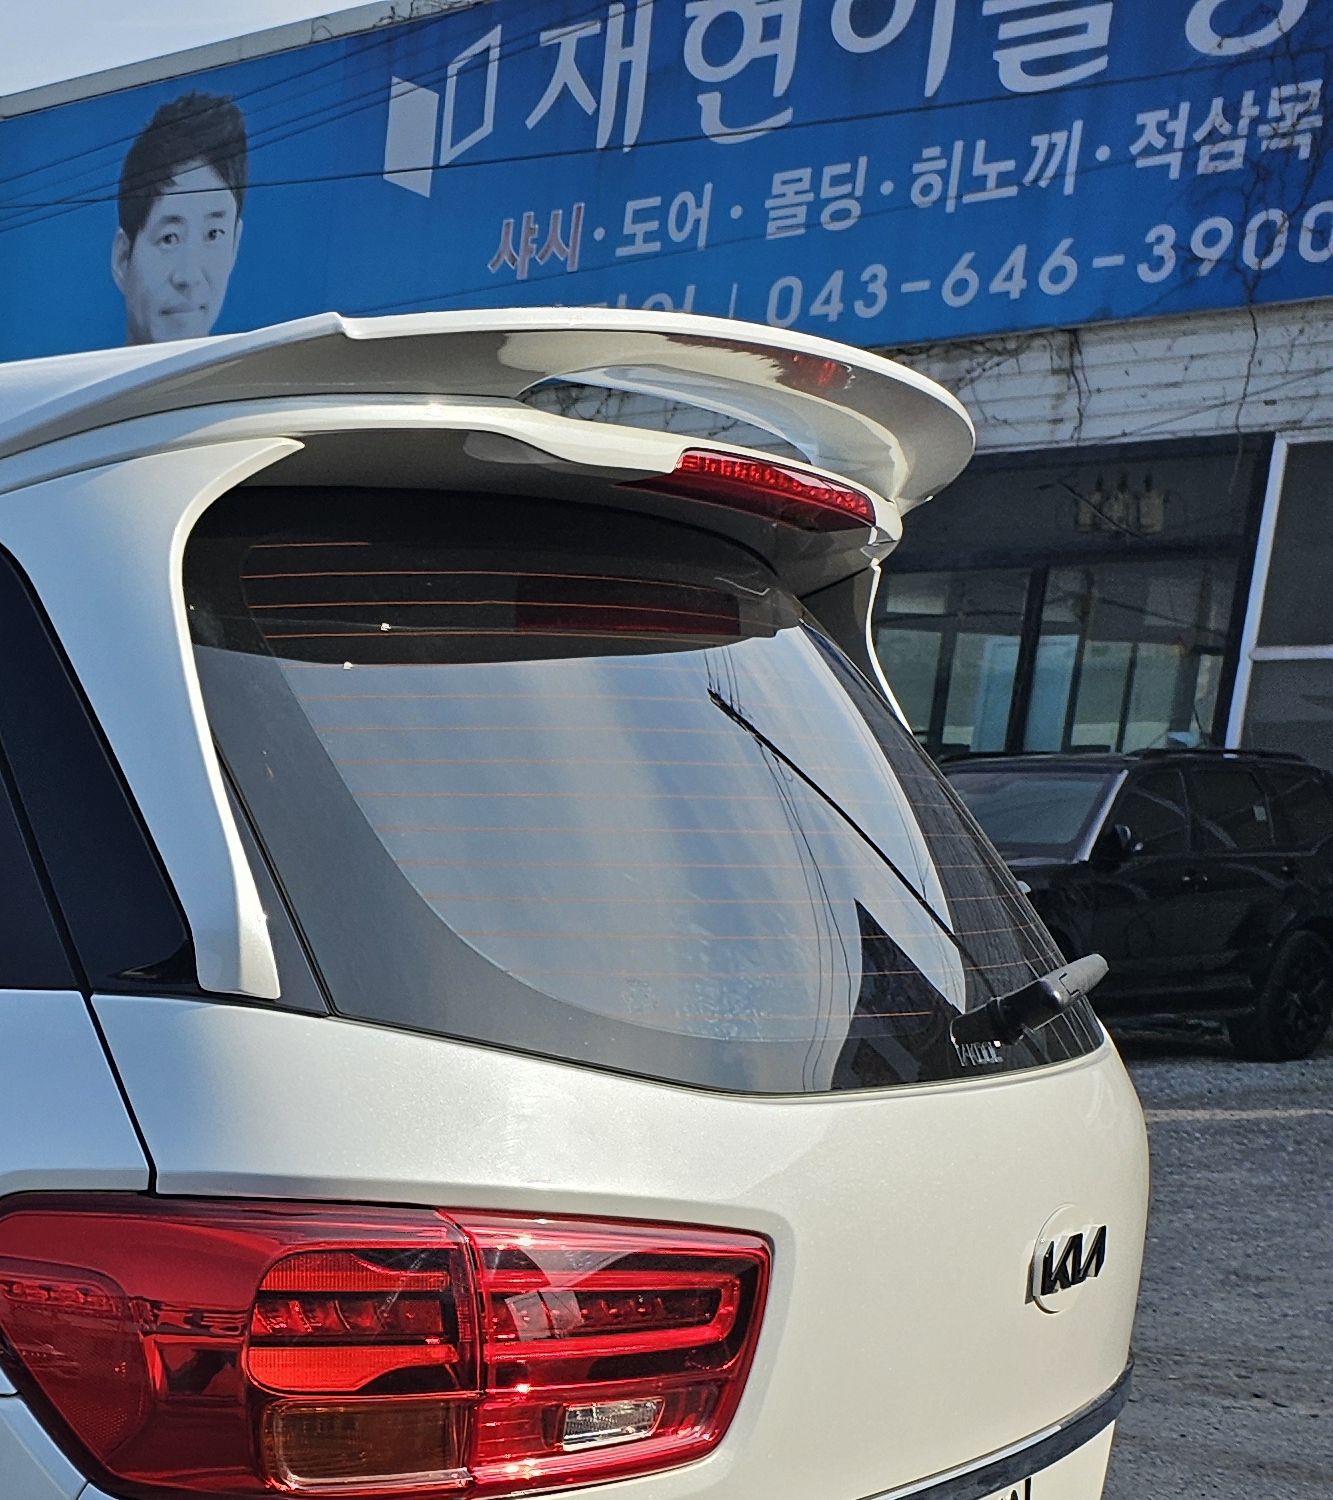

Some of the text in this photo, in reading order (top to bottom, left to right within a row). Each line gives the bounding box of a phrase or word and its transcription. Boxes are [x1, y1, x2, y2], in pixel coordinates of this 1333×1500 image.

[486, 201, 586, 281] 샤시
[614, 181, 714, 258] 도어
[763, 155, 869, 241] 몰딩
[909, 118, 1084, 214] 히노끼
[766, 200, 1333, 328] 043-646-3900
